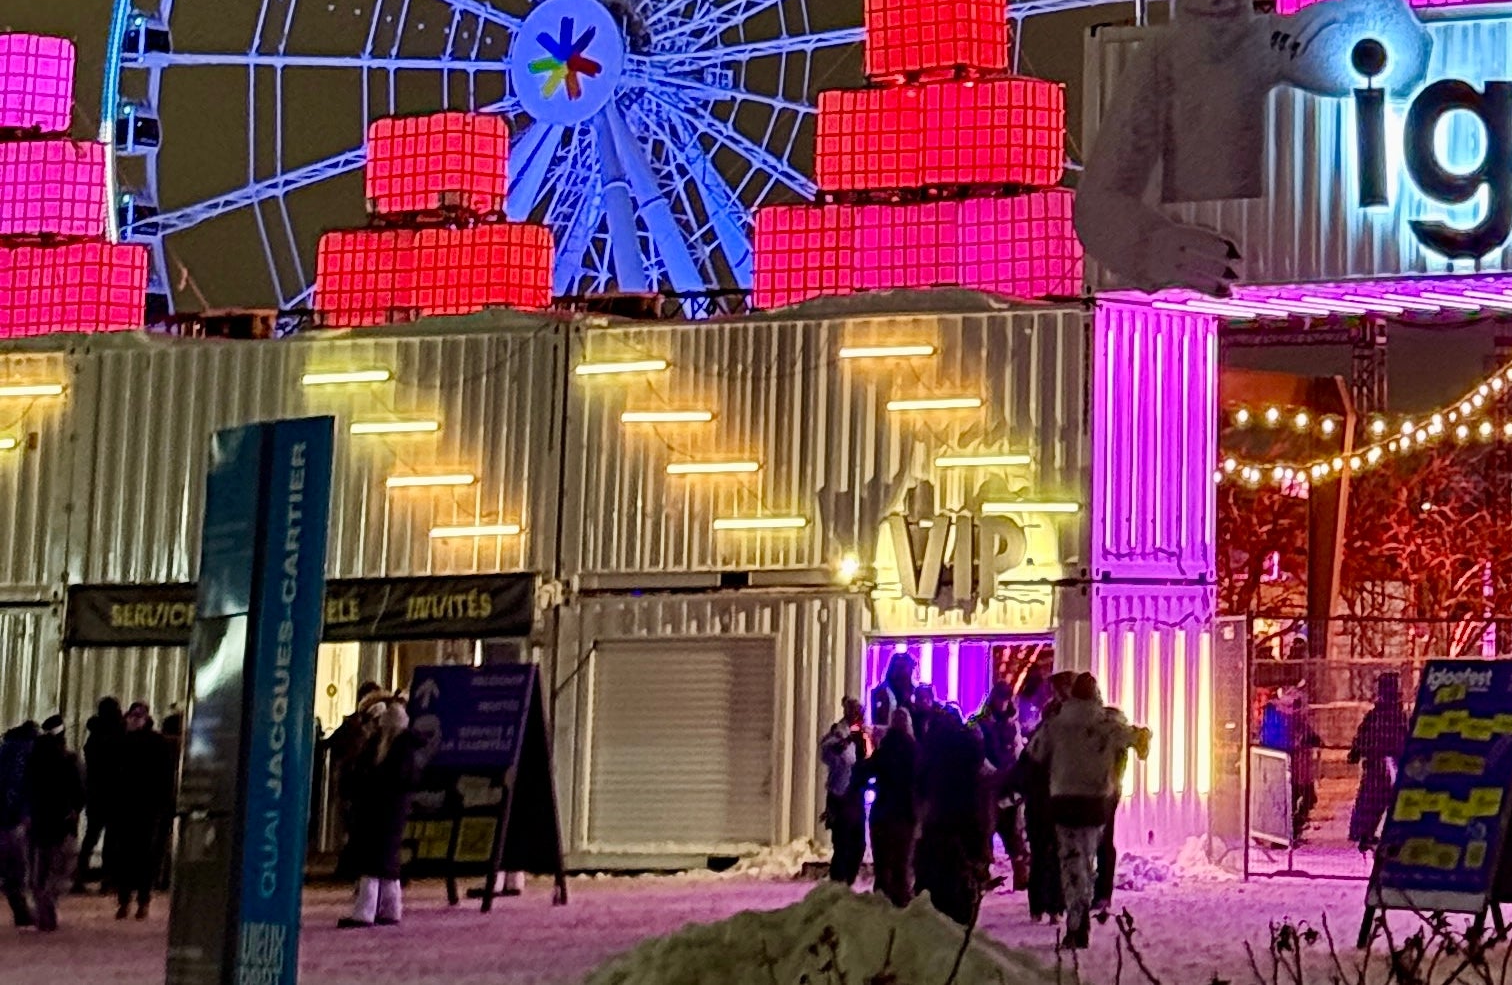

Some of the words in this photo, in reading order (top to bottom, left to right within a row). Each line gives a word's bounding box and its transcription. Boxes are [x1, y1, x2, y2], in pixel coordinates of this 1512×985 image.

[887, 513, 1027, 599] VIP
[265, 441, 307, 800] JACQUES-CARTIER
[1426, 666, 1493, 692] igloofest
[260, 811, 280, 899] QUAI
